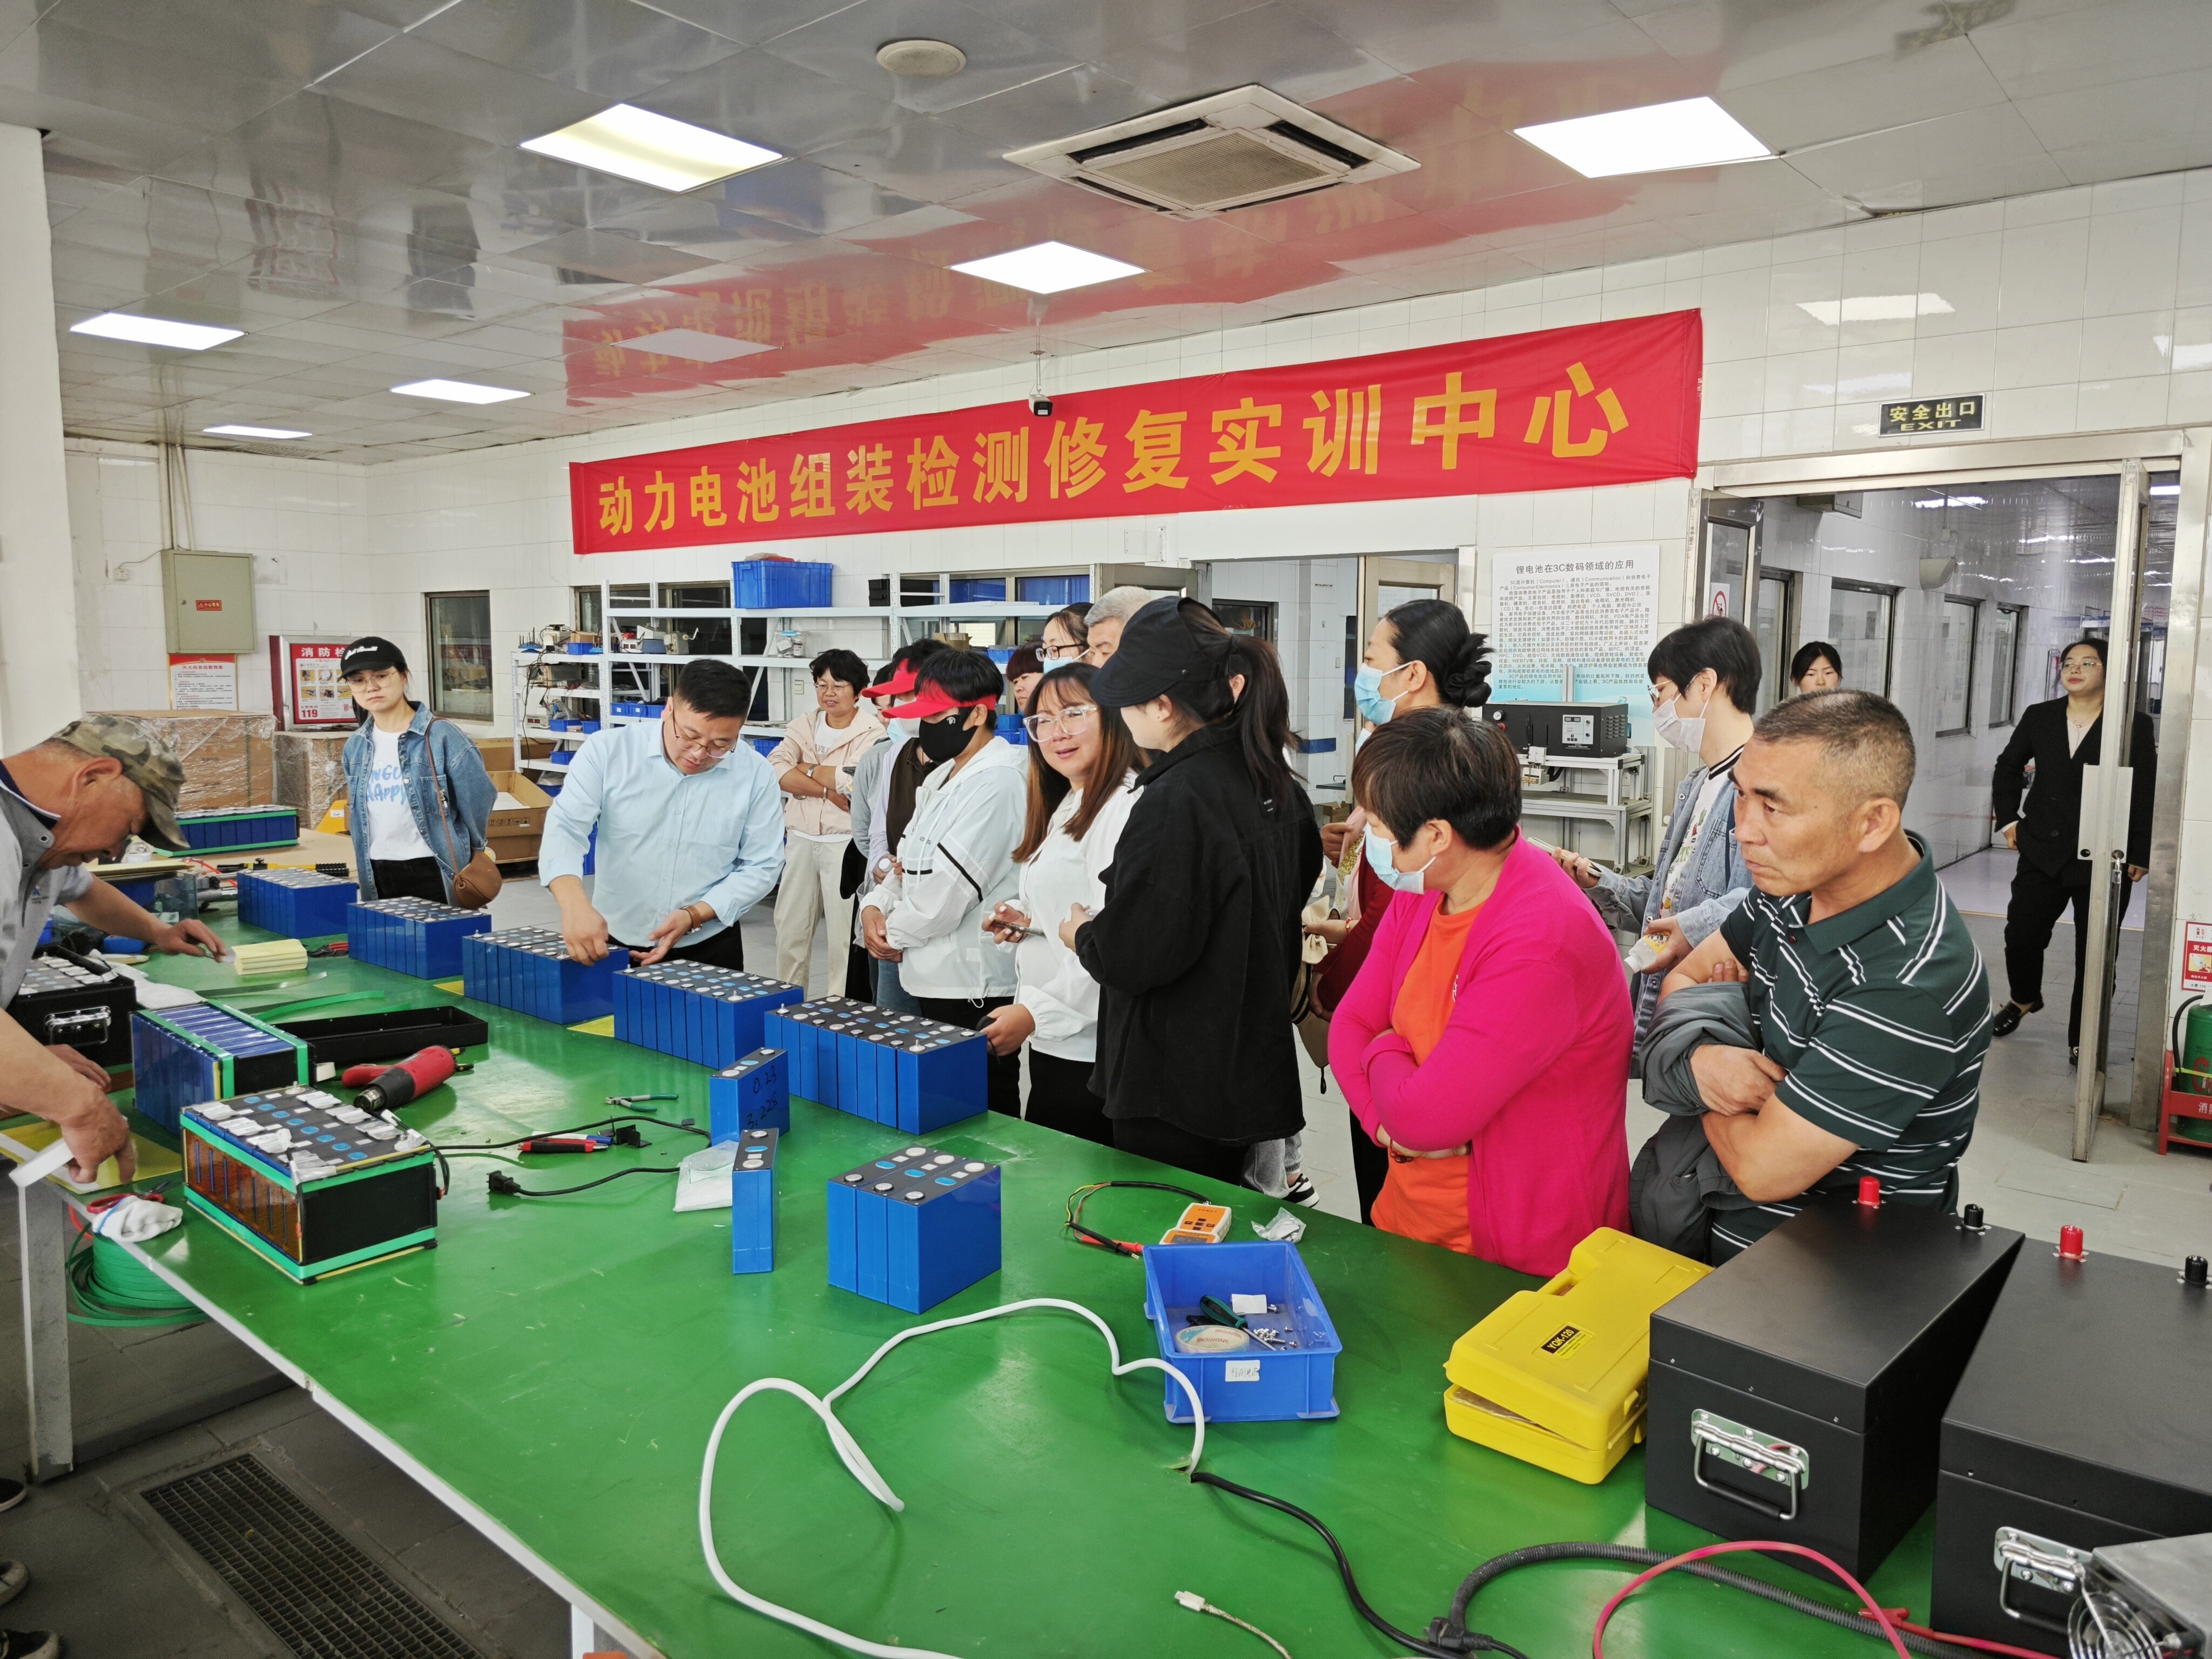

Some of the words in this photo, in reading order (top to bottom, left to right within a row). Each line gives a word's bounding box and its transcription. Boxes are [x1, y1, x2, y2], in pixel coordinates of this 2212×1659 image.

[1890, 401, 1975, 422] 安全出口
[1900, 419, 1961, 431] EXIT
[599, 361, 1629, 536] 动力电池组装检测修复实训中心
[1516, 559, 1634, 574] 锂电池在3C数码领域的应用
[301, 709, 318, 718] 119
[753, 1065, 777, 1094] 0.23
[1547, 1329, 1574, 1349] YQK-120
